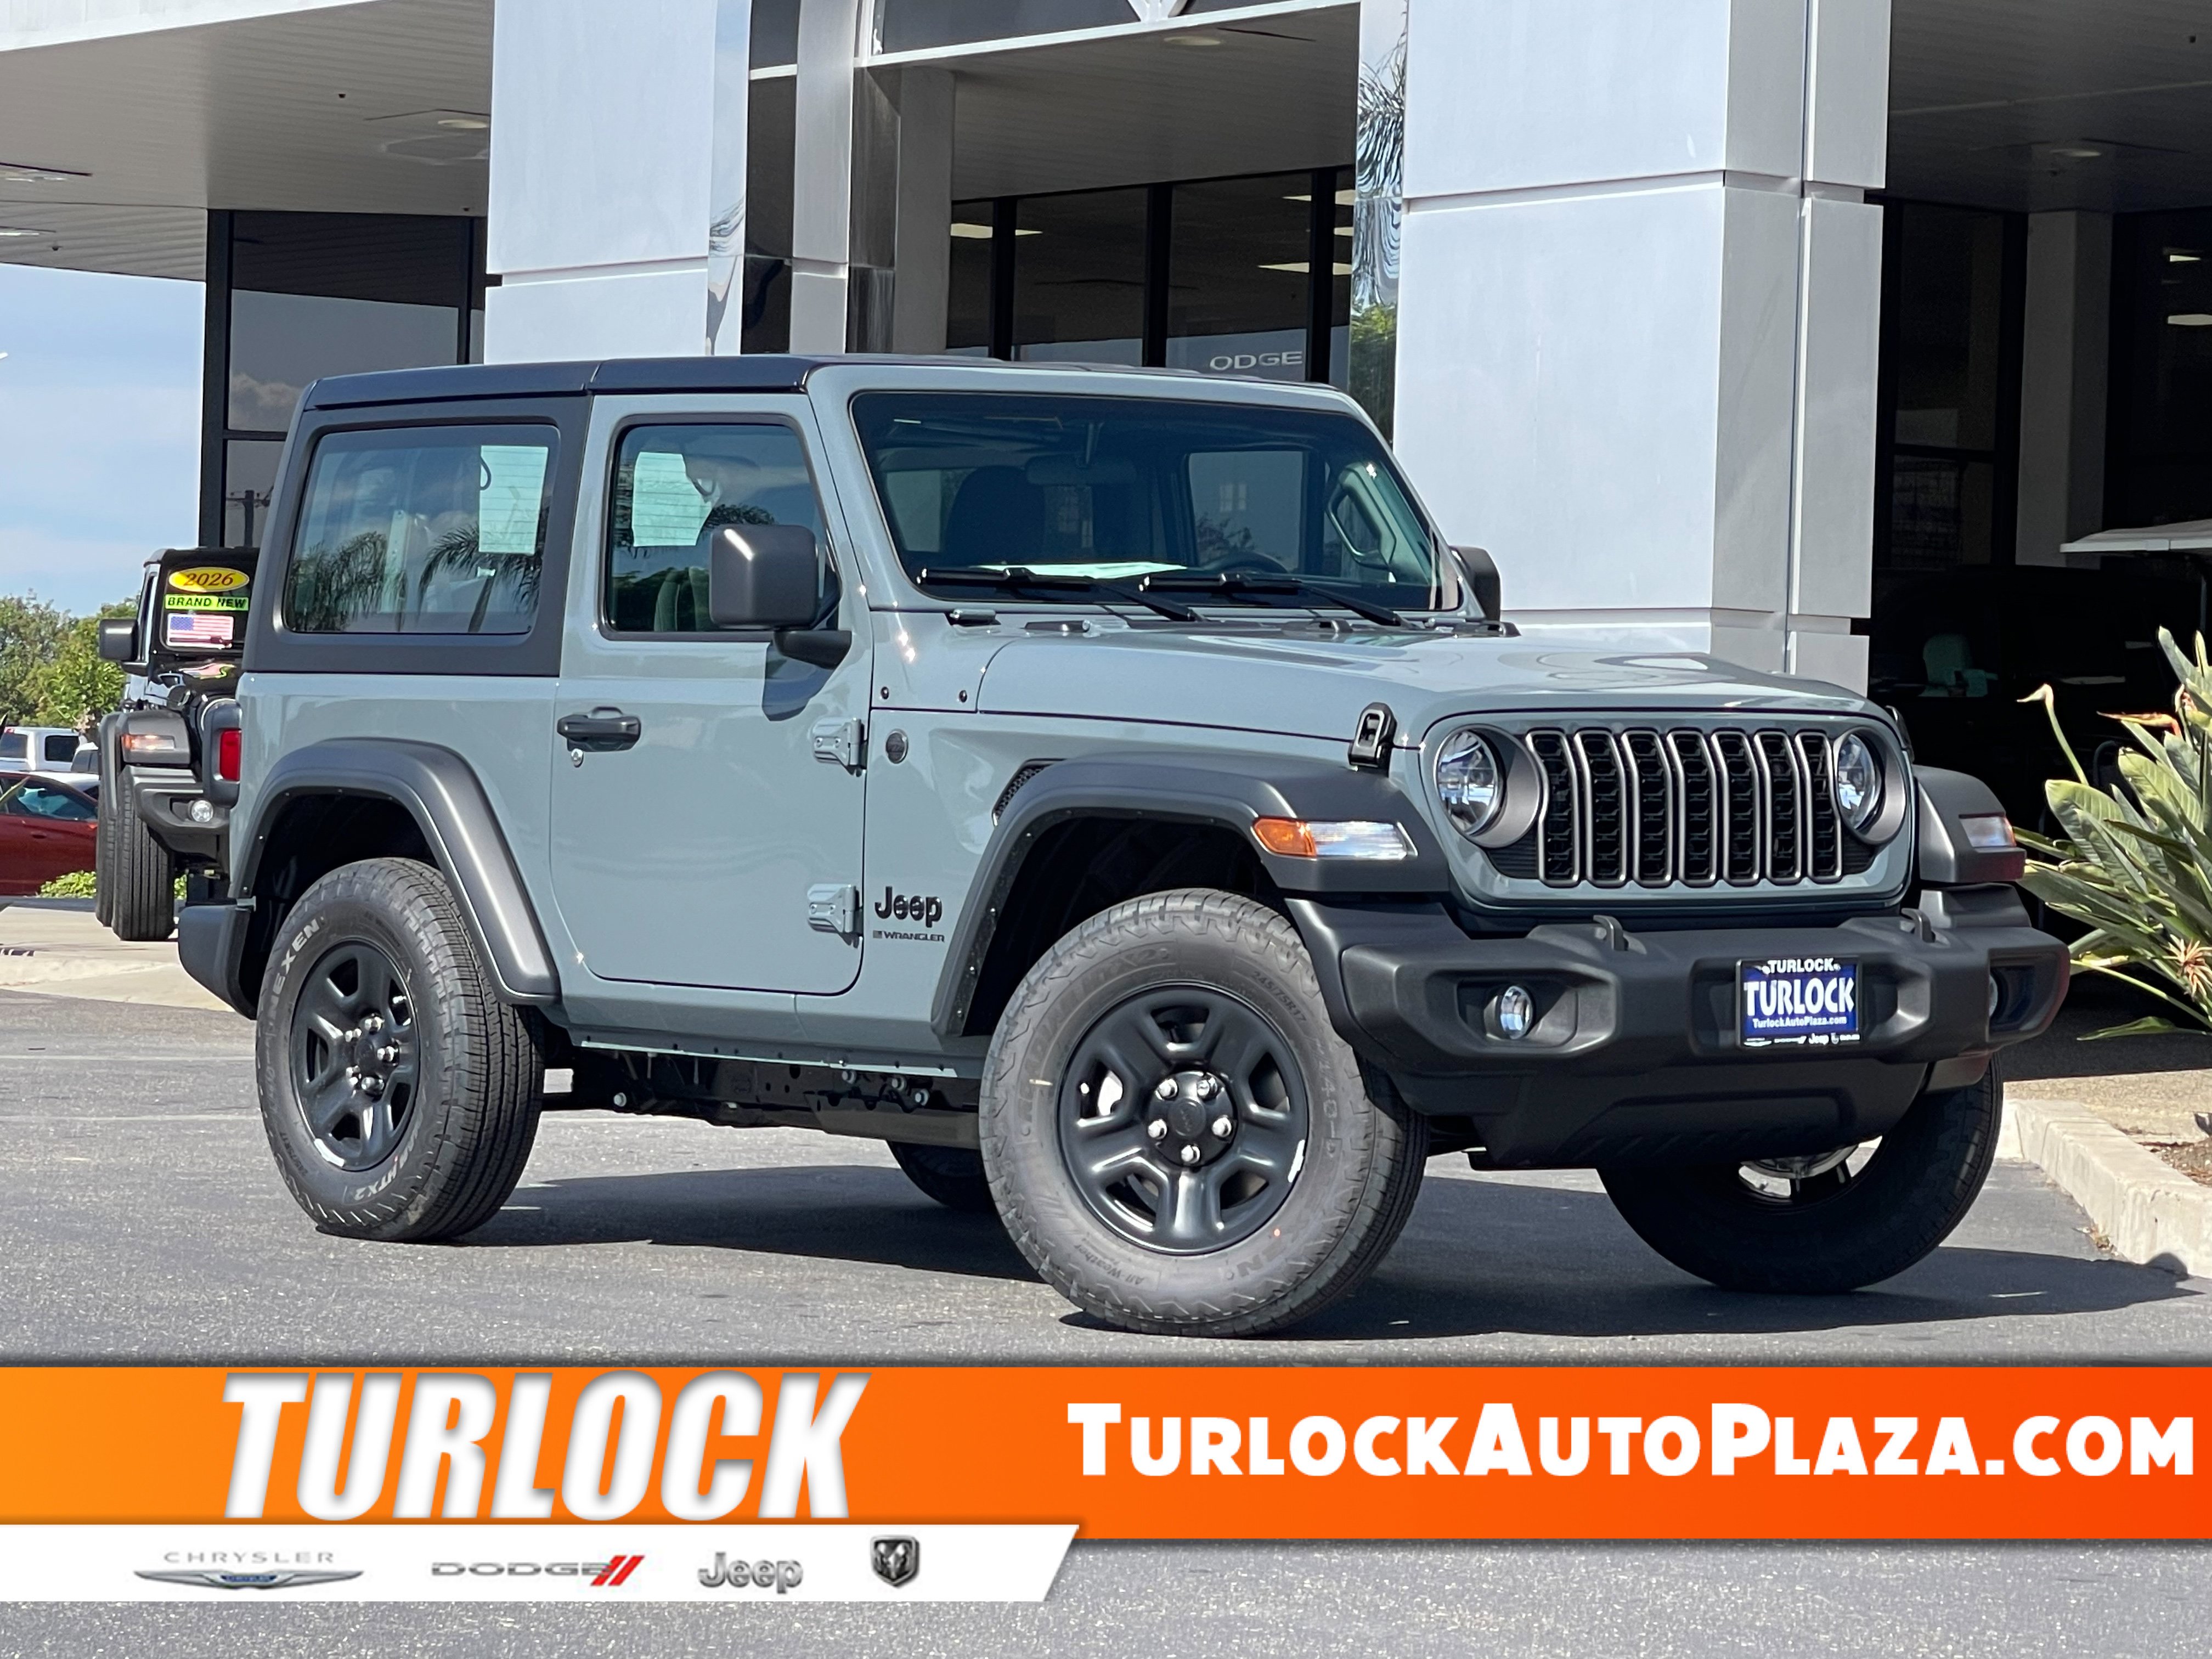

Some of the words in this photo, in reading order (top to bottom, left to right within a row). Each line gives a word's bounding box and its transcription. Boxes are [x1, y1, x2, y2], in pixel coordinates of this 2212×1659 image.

[184, 573, 235, 586] 2026
[168, 597, 212, 606] BRAND
[217, 597, 246, 608] NEW
[874, 886, 942, 928] Jeep
[883, 930, 945, 942] WRANGLER
[269, 918, 319, 1017] NEXEN
[1768, 958, 1834, 973] TURLOCK
[1743, 978, 1854, 1016] TURLOCK
[1752, 1017, 1847, 1028] TurlockAutoPlaza.com
